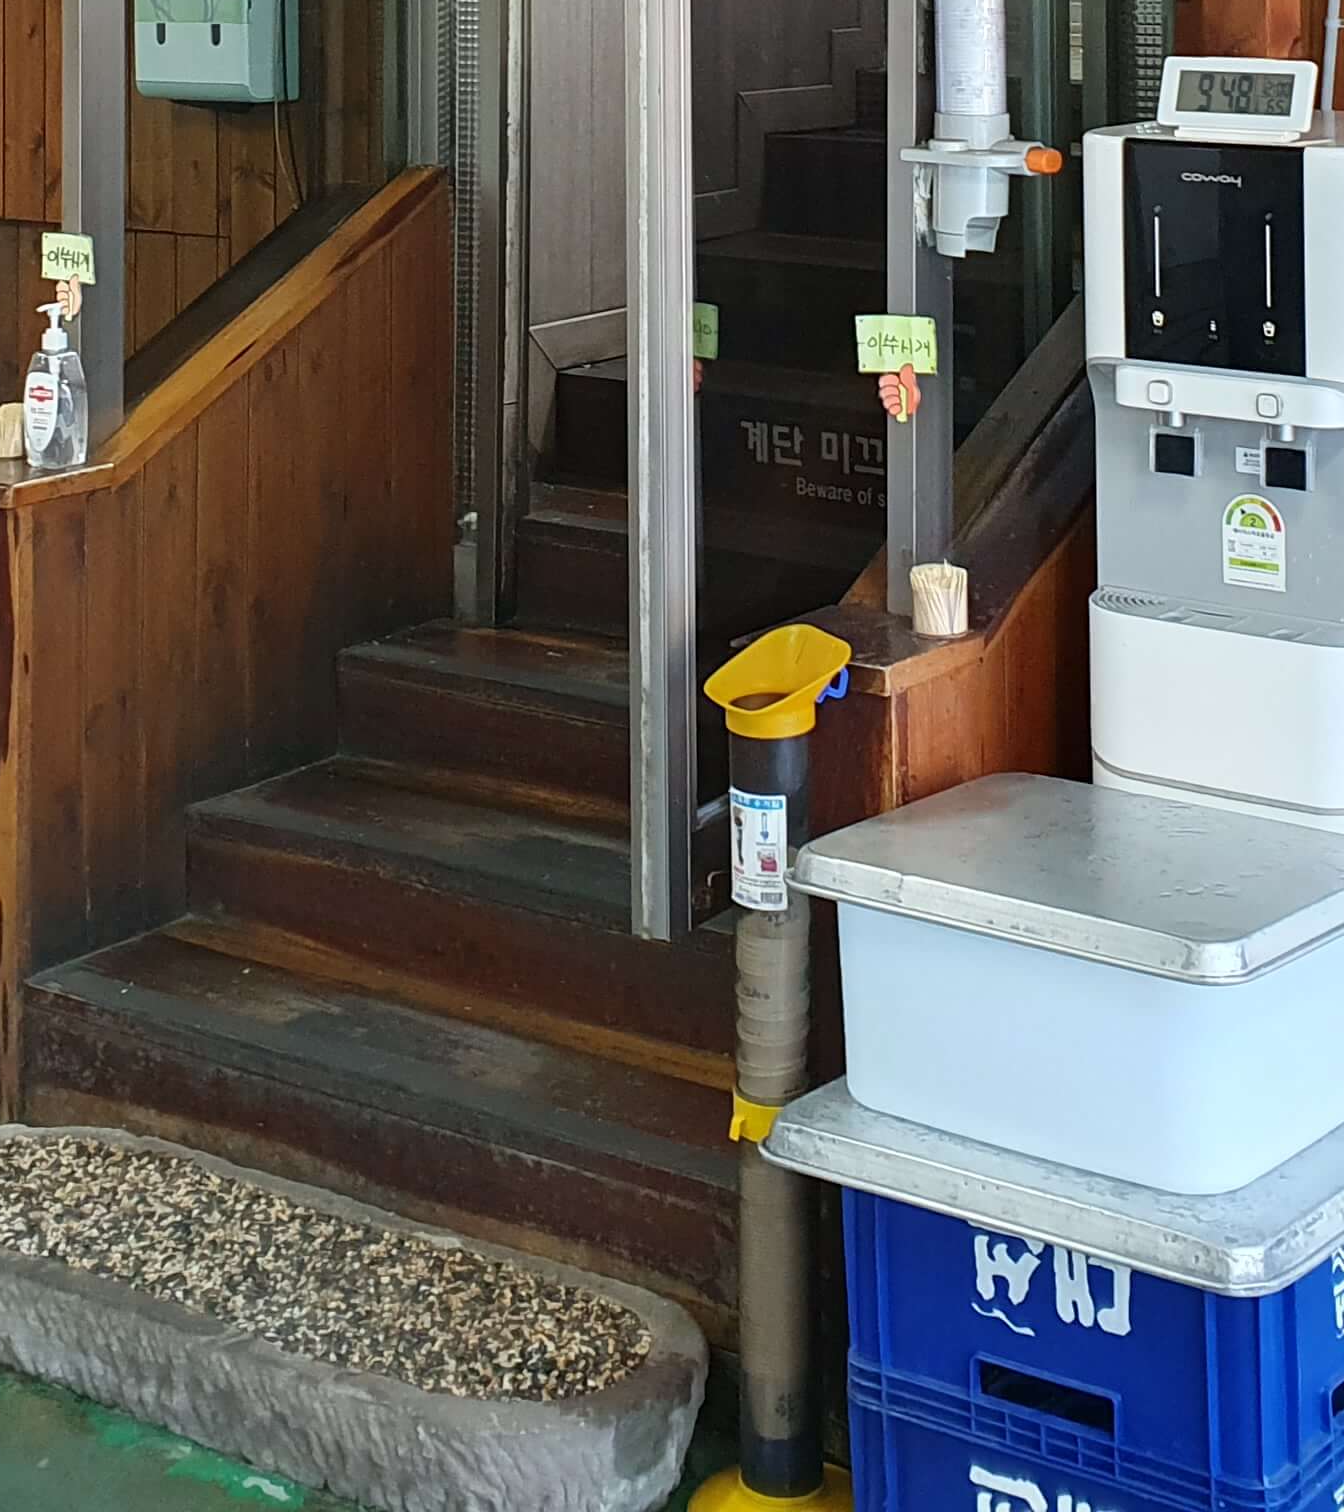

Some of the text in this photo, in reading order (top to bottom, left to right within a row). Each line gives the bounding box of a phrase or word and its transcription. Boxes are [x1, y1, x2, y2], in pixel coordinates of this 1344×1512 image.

[1181, 172, 1242, 188] coway
[740, 420, 804, 467] 계단
[796, 476, 853, 503] Beware
[857, 487, 873, 505] of
